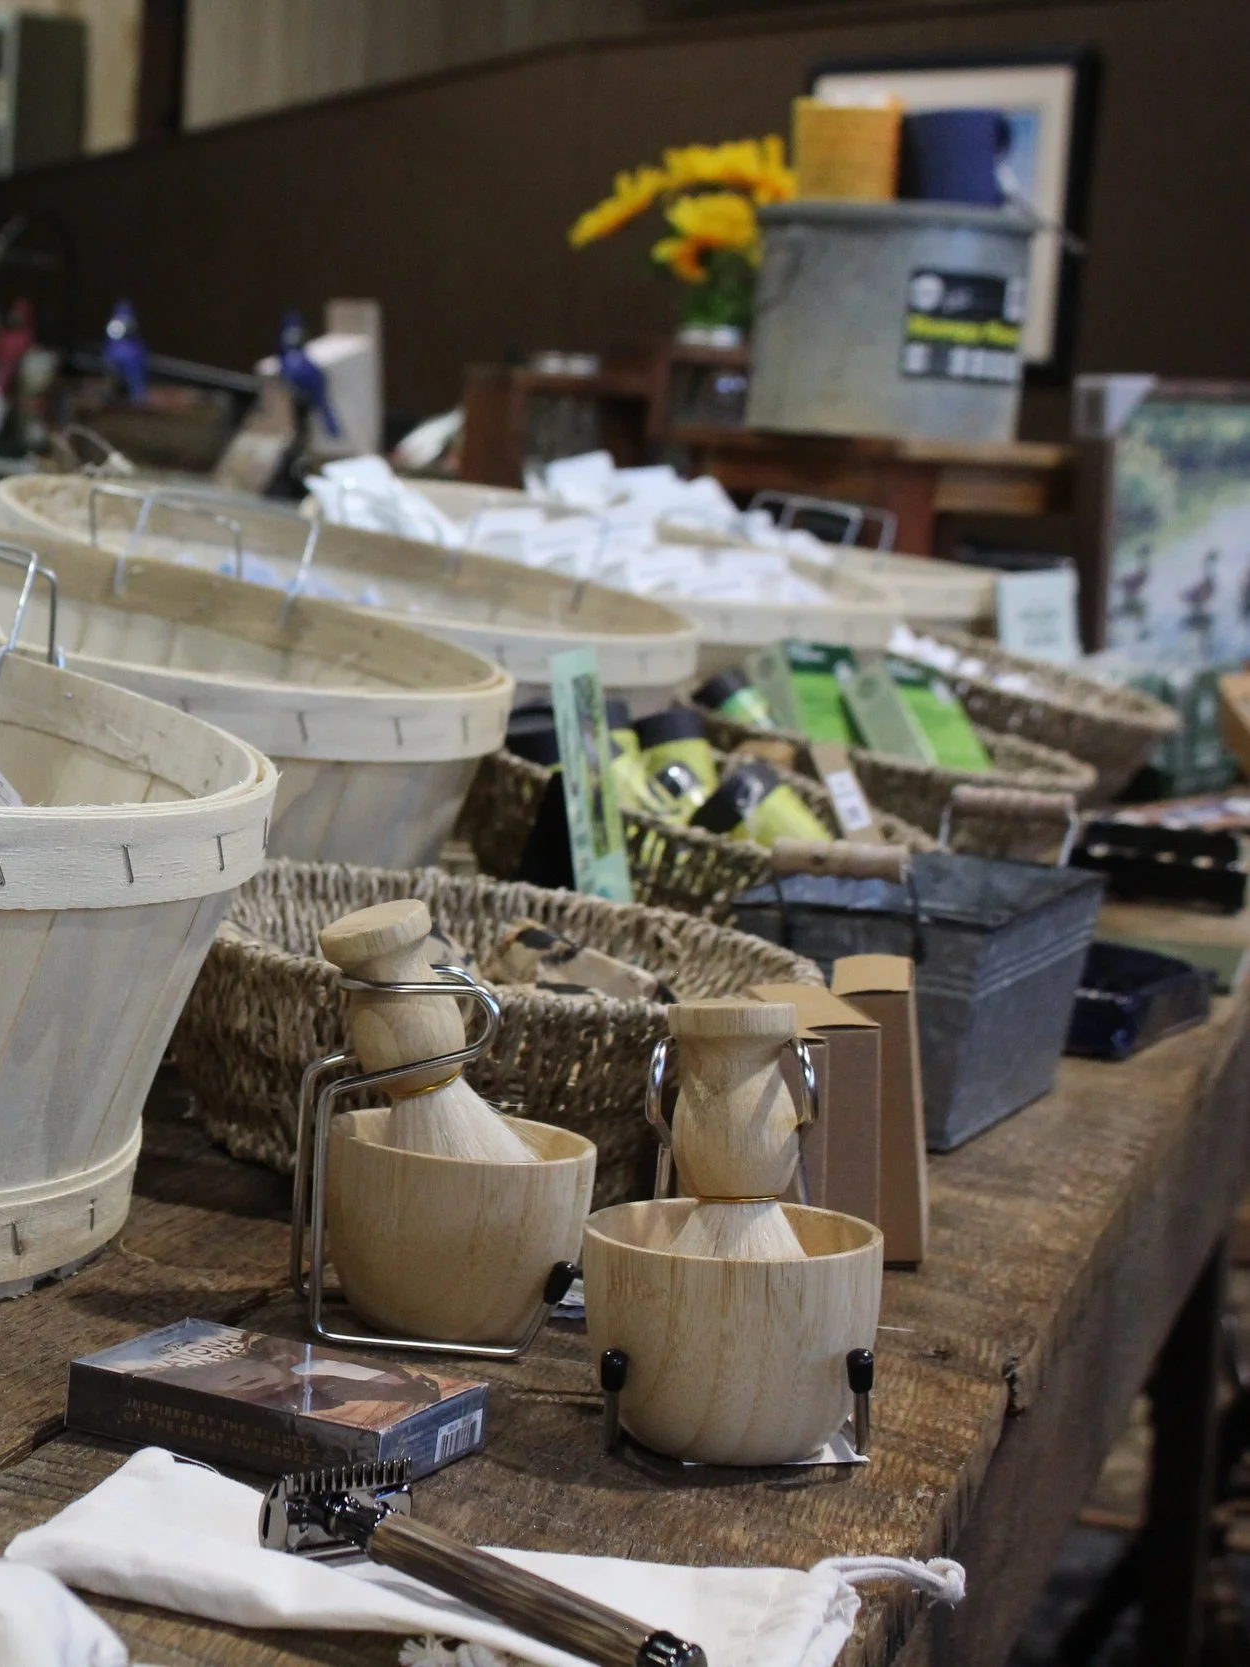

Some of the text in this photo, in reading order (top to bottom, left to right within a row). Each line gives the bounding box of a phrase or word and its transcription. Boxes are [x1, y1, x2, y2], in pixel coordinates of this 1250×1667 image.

[123, 1398, 192, 1421] INSPIRED
[198, 1413, 215, 1426] BY
[221, 1419, 248, 1434] THE
[150, 1416, 176, 1432] THE
[180, 1423, 224, 1443] GREAT
[230, 1437, 312, 1465] OUTDOORS
